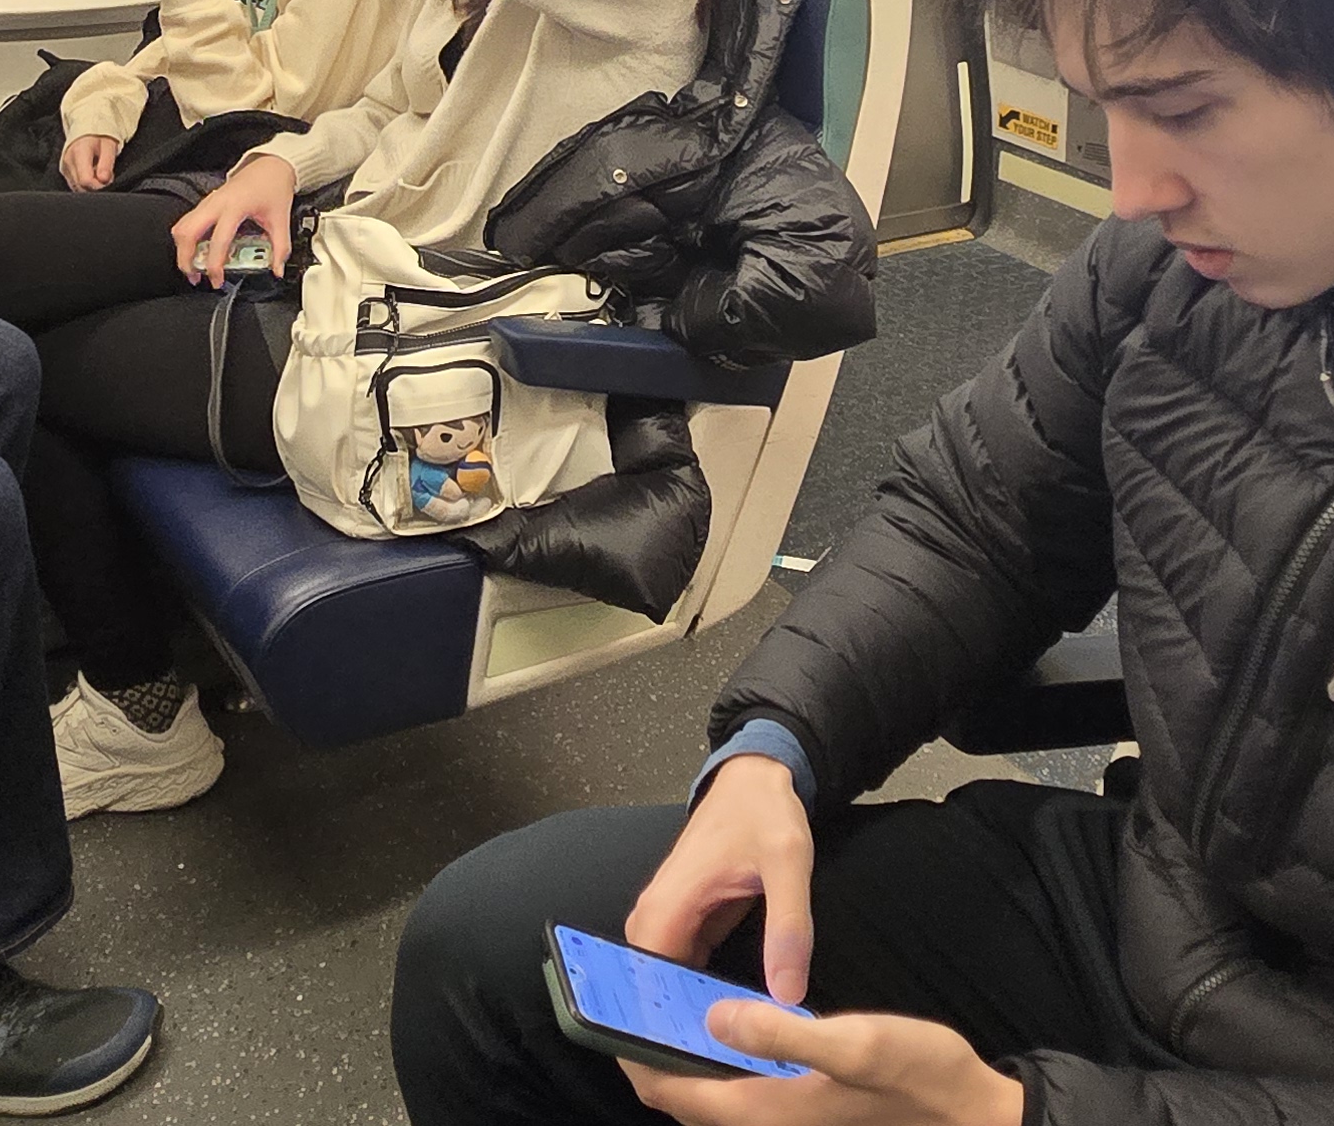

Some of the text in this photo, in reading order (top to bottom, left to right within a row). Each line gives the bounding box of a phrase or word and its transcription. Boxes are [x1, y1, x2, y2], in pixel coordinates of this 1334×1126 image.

[1023, 113, 1050, 130] WATCH
[1013, 123, 1058, 145] YOUR STEP
